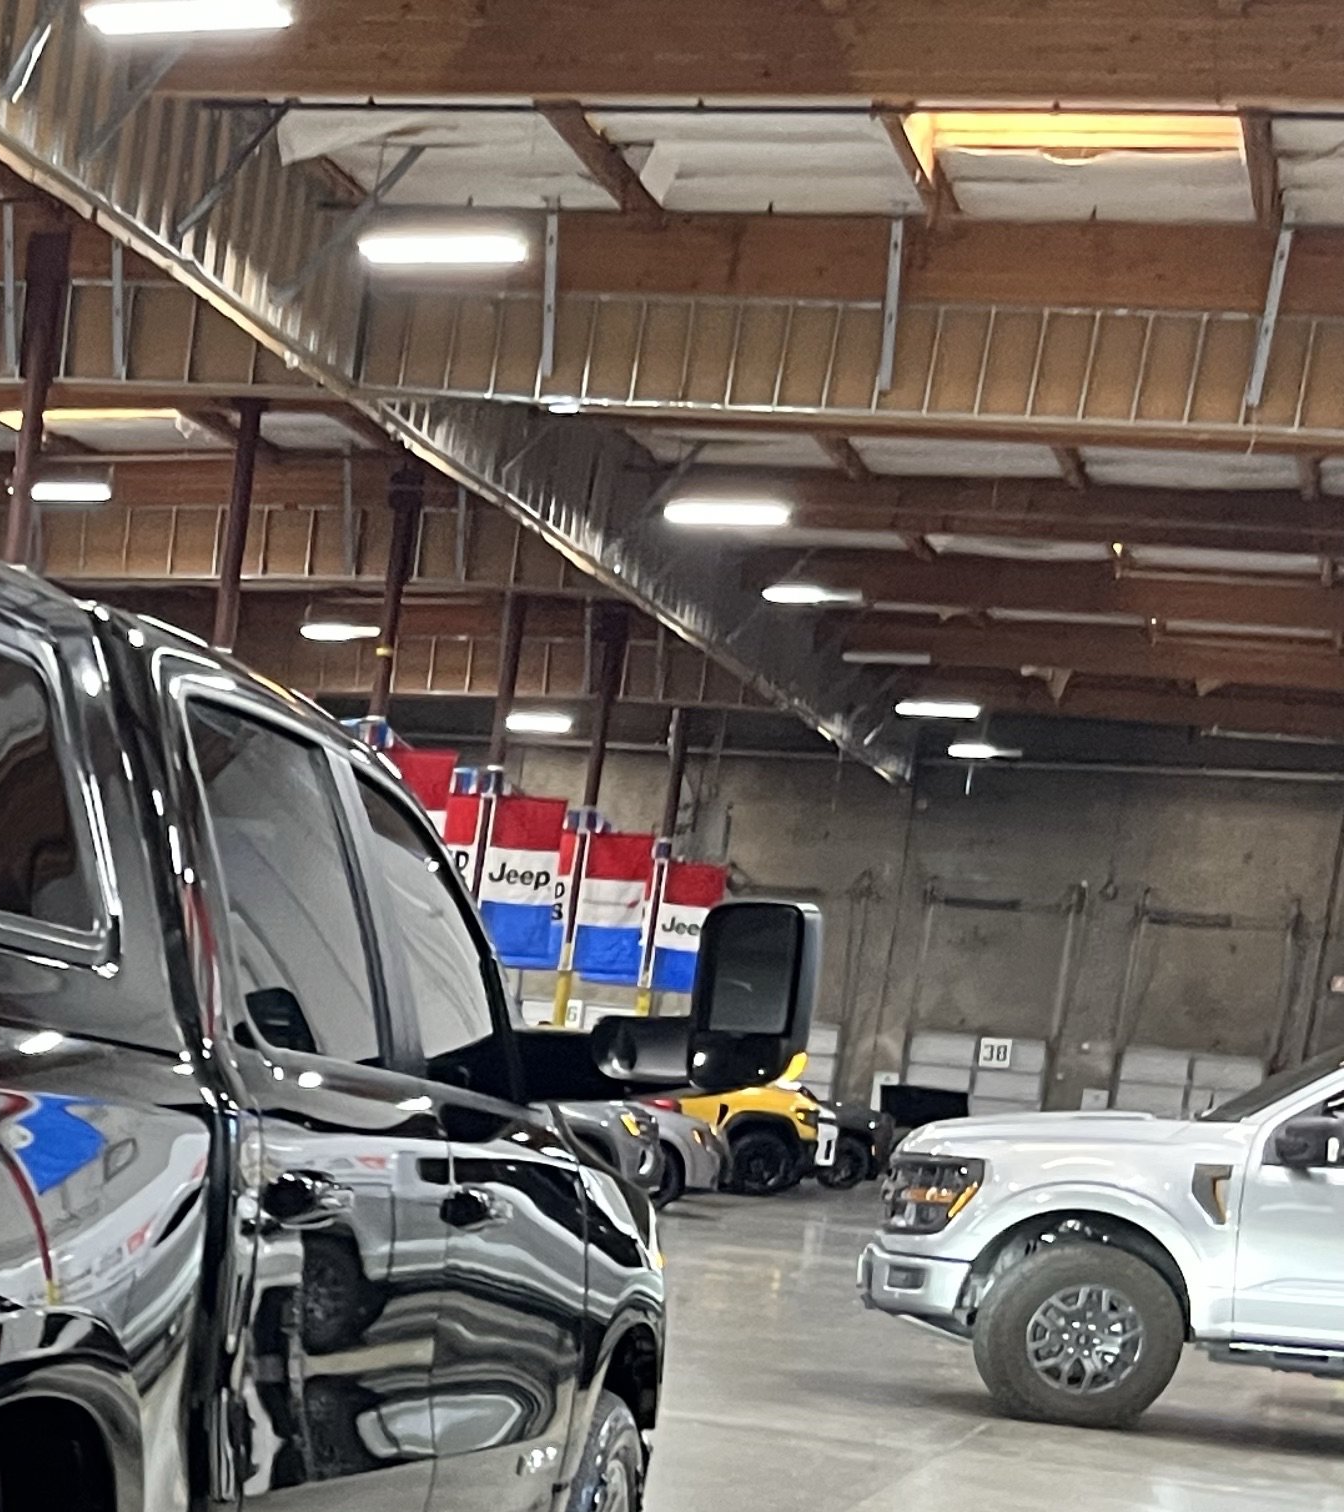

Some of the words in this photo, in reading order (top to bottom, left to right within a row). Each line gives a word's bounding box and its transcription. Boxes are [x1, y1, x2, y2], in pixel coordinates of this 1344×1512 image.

[488, 862, 551, 891] Jeep
[662, 916, 700, 936] Jee
[983, 1044, 1008, 1062] 38
